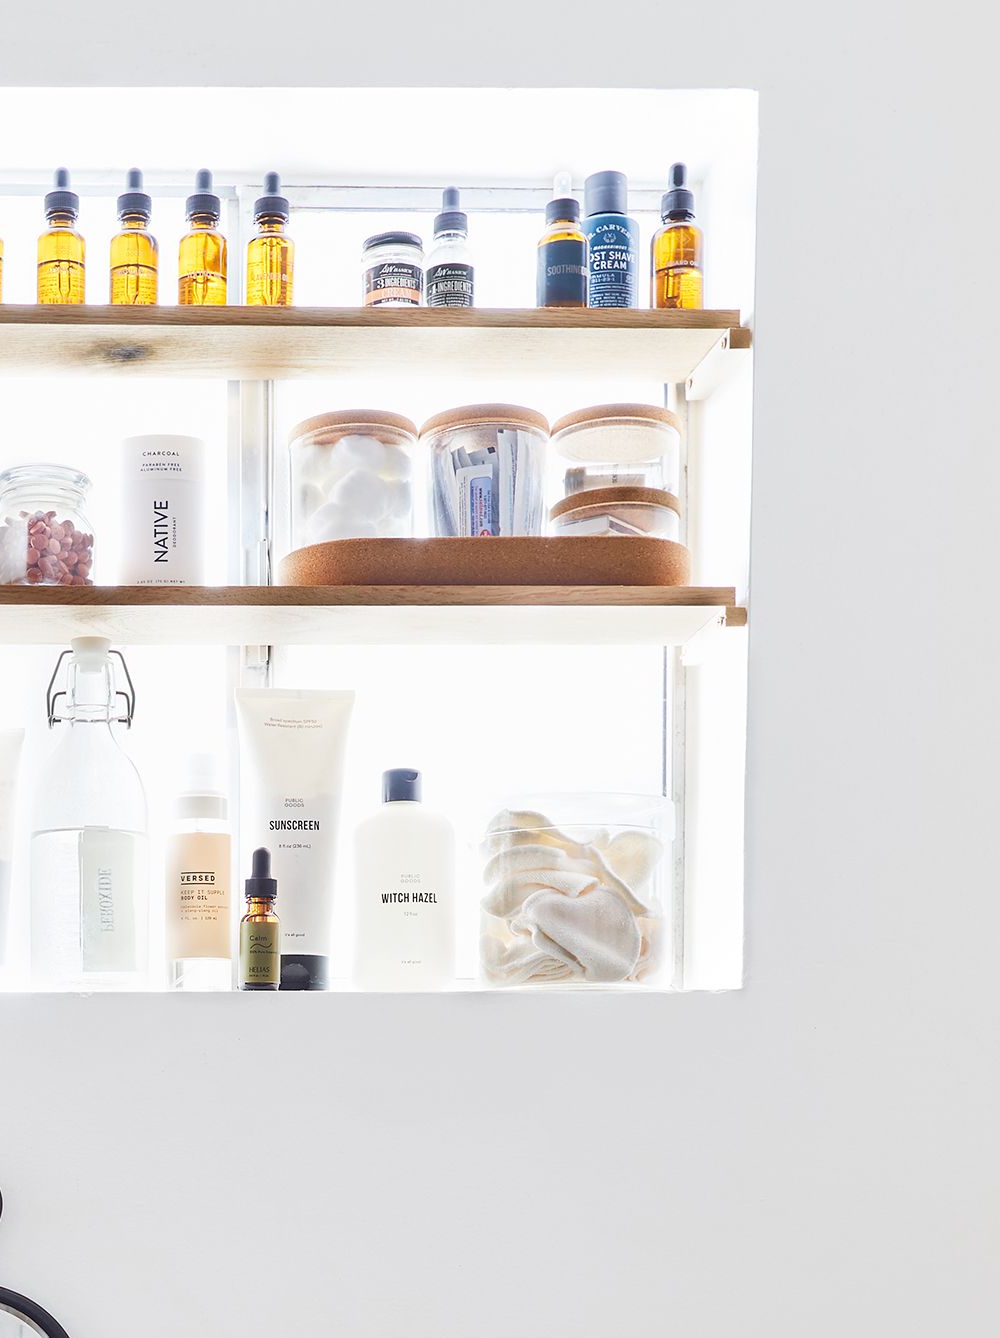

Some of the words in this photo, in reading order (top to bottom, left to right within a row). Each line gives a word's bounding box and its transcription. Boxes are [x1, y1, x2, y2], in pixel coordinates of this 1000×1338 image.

[593, 260, 627, 271] CREAM
[154, 500, 169, 563] NATIVE
[269, 820, 320, 831] SUNSCREEN
[180, 874, 216, 882] VERSED
[381, 892, 410, 904] WITCH
[412, 892, 438, 904] HAZEL
